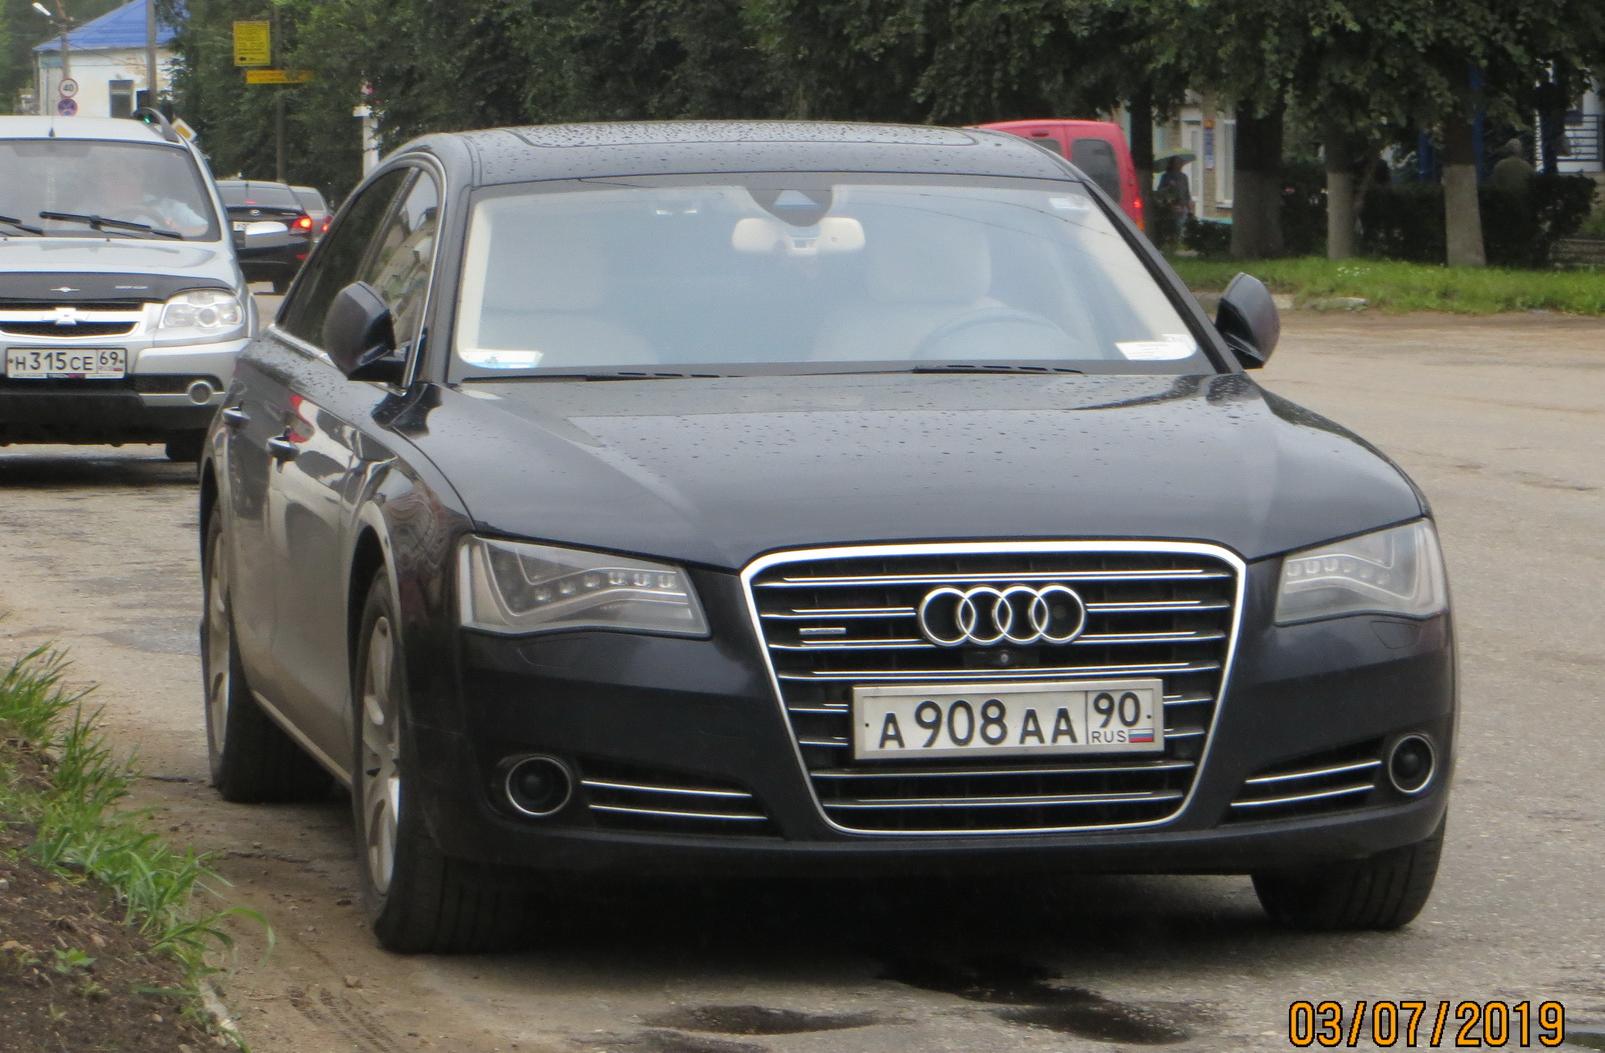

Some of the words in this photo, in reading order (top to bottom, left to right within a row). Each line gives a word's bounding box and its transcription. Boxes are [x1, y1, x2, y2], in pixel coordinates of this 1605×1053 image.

[63, 83, 75, 92] 40
[99, 351, 119, 366] 69
[1093, 691, 1141, 729] 90
[1091, 729, 1127, 744] RUS
